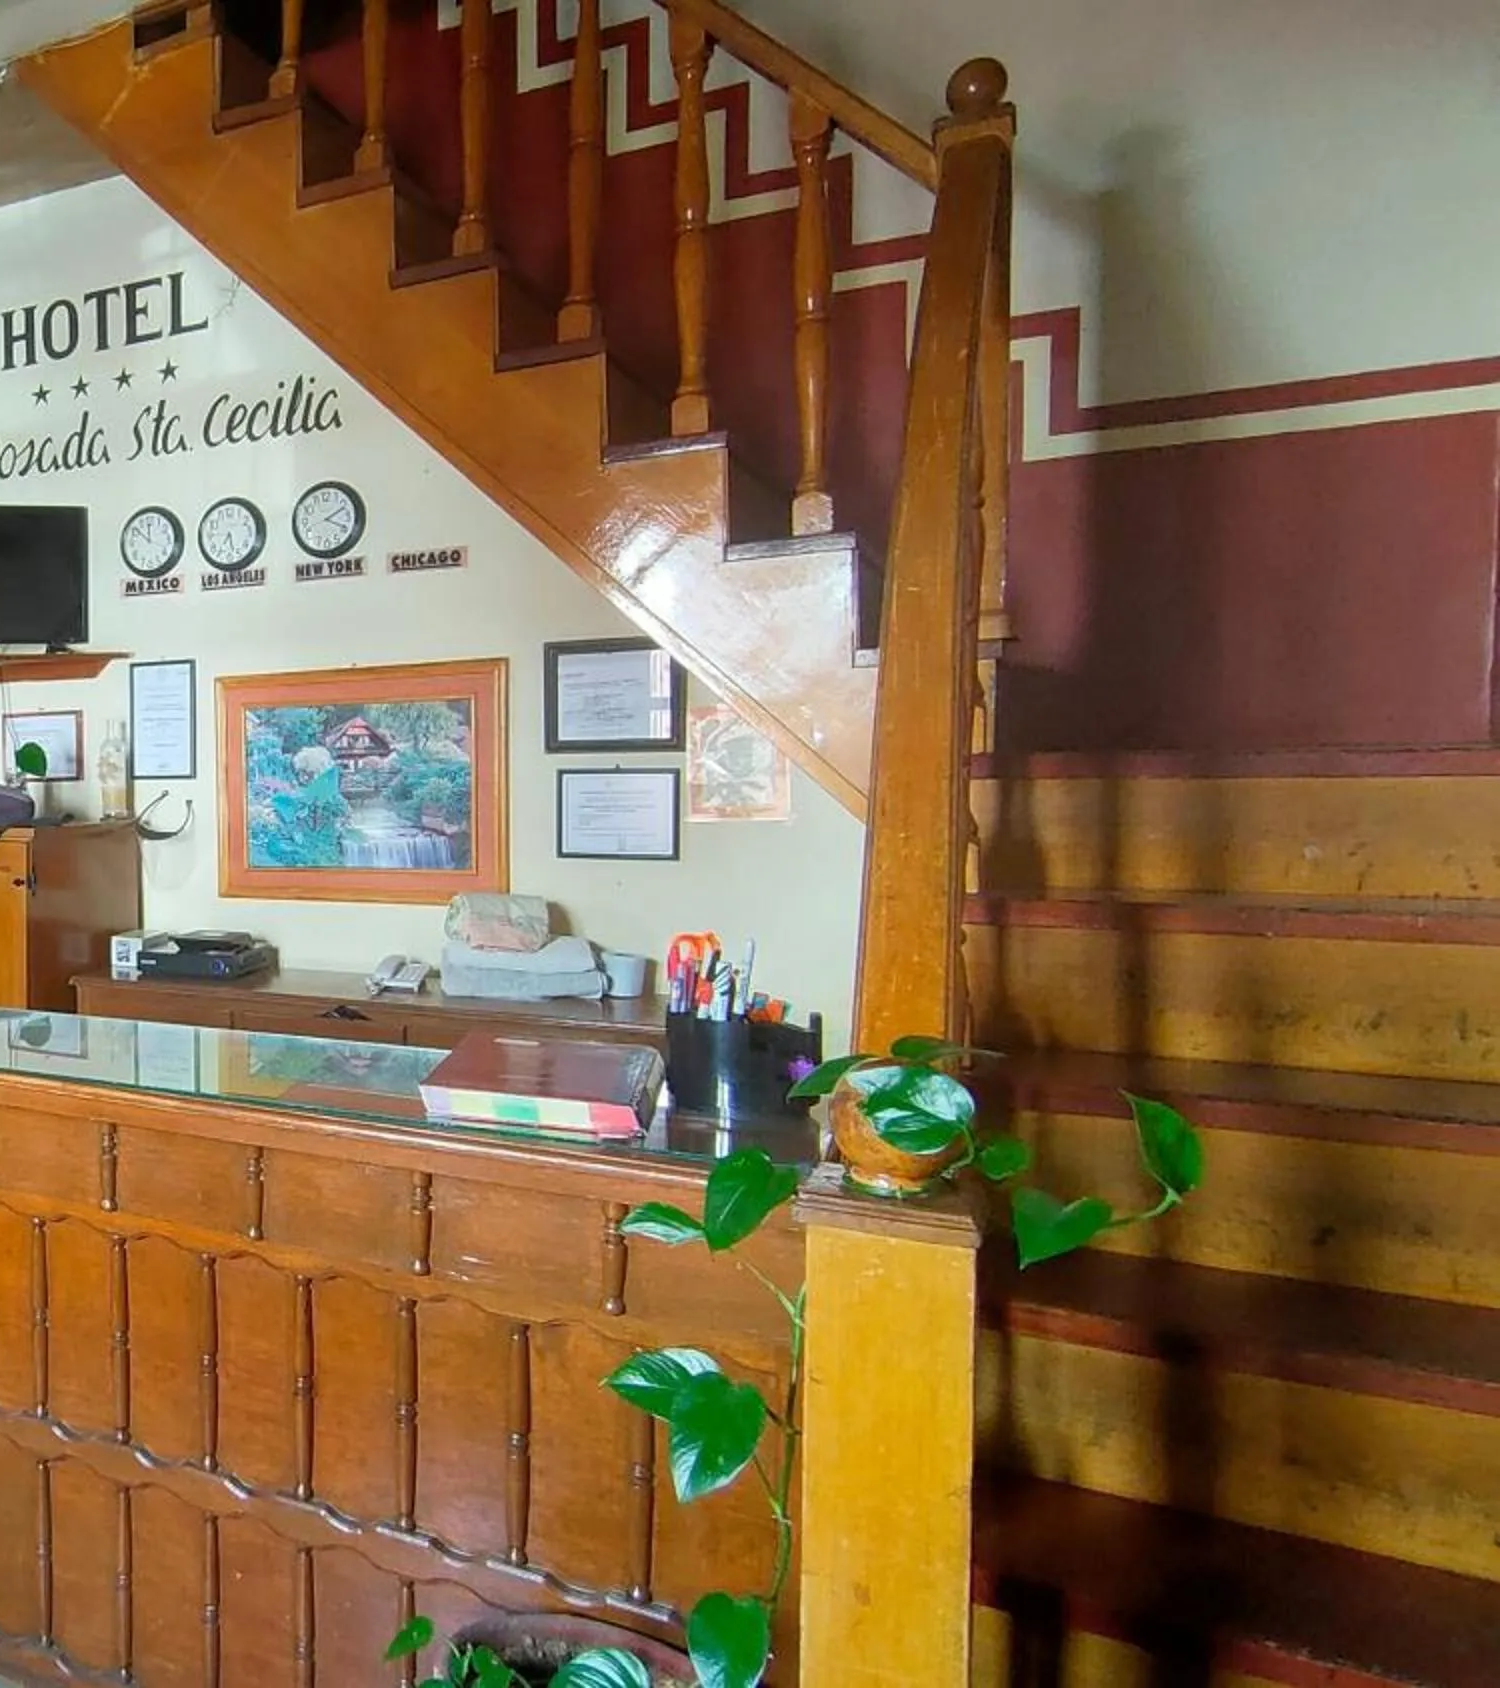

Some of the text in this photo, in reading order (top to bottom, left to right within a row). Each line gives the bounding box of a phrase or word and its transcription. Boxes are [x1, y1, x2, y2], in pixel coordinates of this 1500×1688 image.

[1, 271, 209, 371] HOTEL
[126, 399, 194, 461] Sta.
[203, 373, 343, 448] Cecilia
[296, 558, 363, 577] NEW YORK
[391, 549, 462, 570] CHICAGO
[125, 577, 180, 593] MEXICO
[201, 572, 219, 588] LOS
